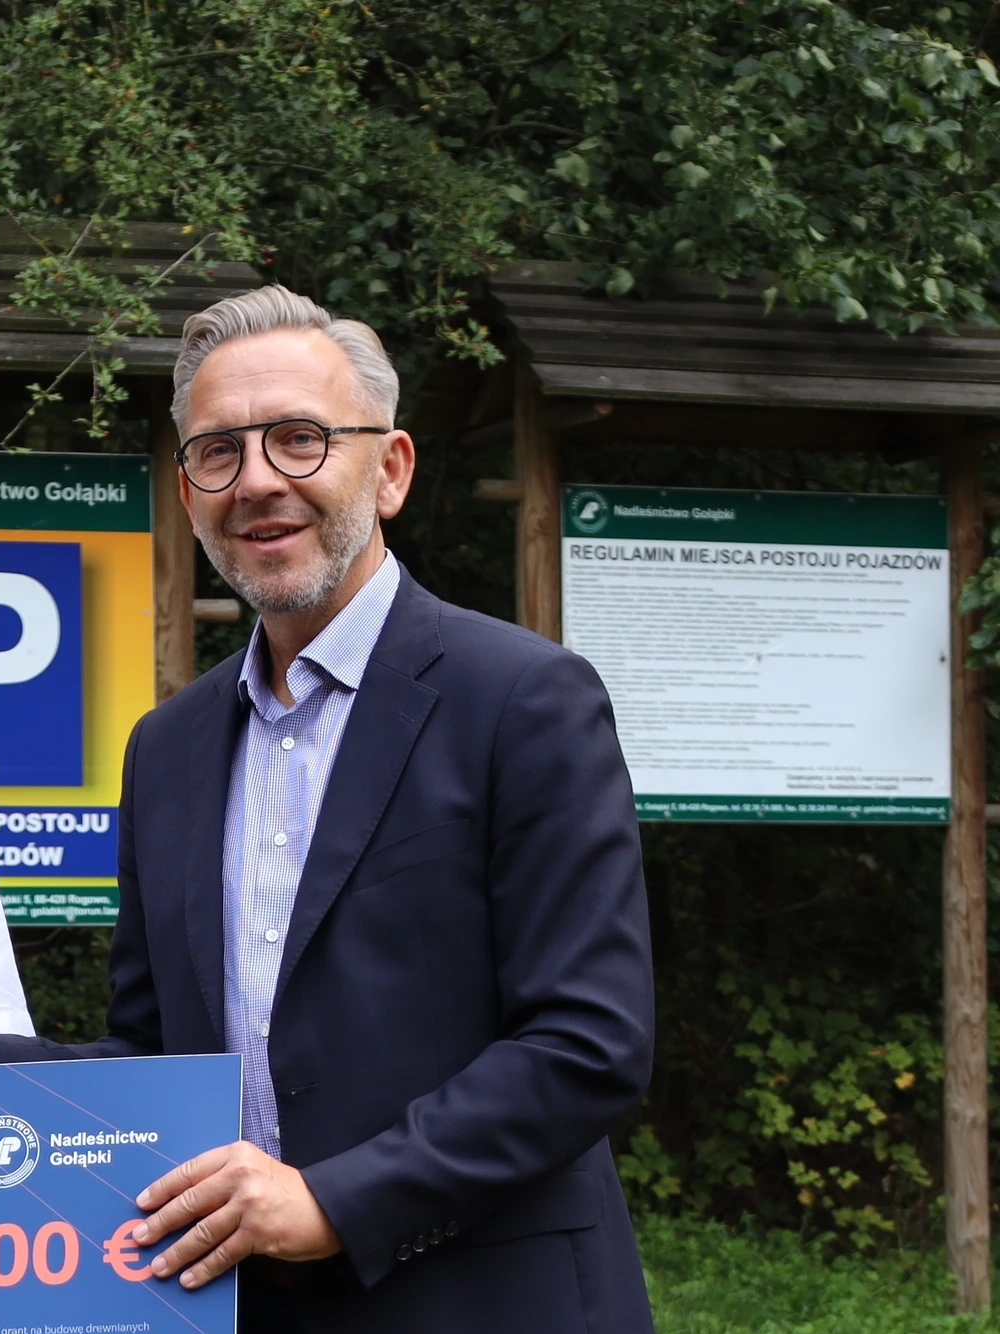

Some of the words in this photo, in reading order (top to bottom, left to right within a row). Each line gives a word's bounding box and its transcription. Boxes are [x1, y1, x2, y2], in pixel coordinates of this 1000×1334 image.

[44, 481, 127, 506] Gołąbki
[613, 504, 690, 518] Nadleśnictwo
[691, 506, 737, 521] Gołąbki
[570, 544, 674, 562] REGULAMIN
[680, 548, 756, 565] MIEJSCA
[760, 550, 841, 568] POSTOJU
[846, 551, 942, 570] POJAZDÓW
[50, 1130, 159, 1148] Nadleśnictwo
[50, 1149, 112, 1168] Gołąbki
[102, 1218, 154, 1282] €
[30, 1327, 42, 1334] na
[86, 1321, 150, 1334] drewnianych
